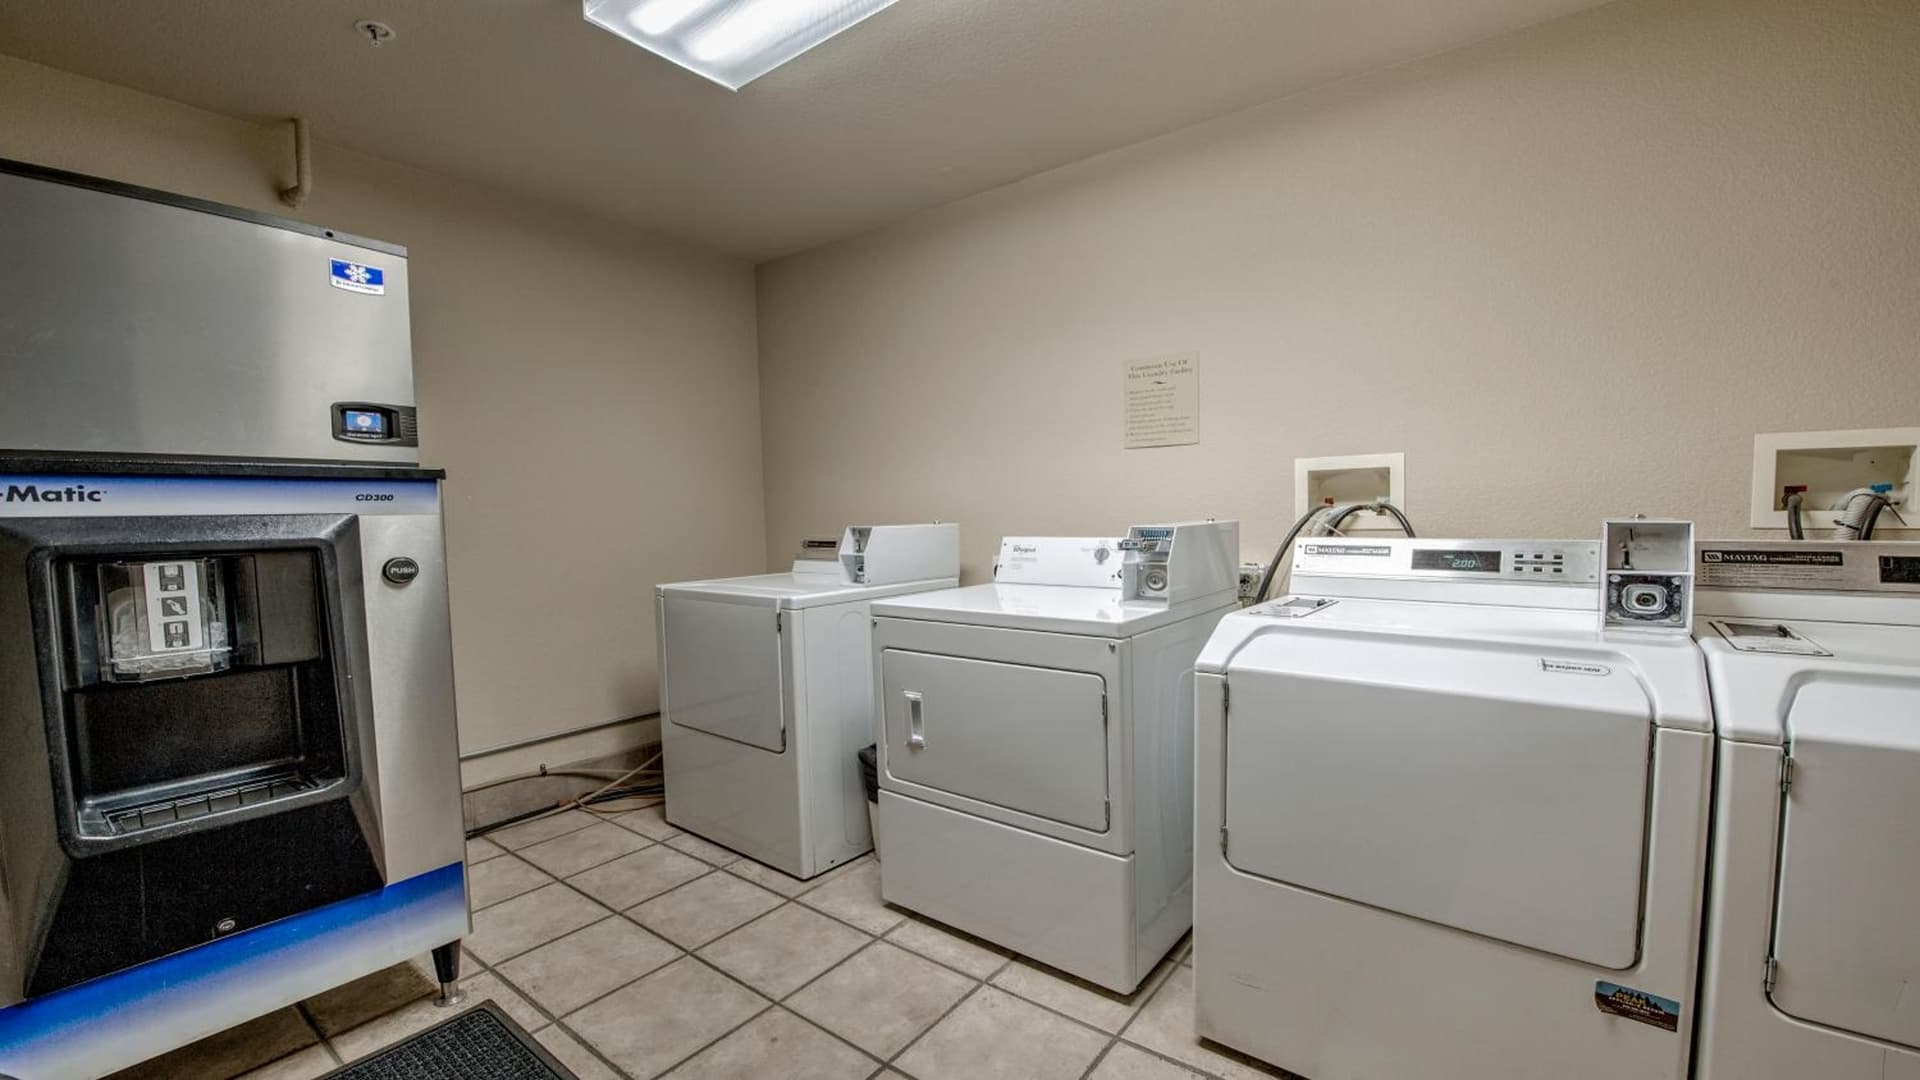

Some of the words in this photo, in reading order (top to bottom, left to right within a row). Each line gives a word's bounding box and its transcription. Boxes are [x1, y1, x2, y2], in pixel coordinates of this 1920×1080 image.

[1723, 553, 1767, 562] MAYTAG
[390, 567, 415, 575] PUSH
[1615, 991, 1646, 1007] PEAK
